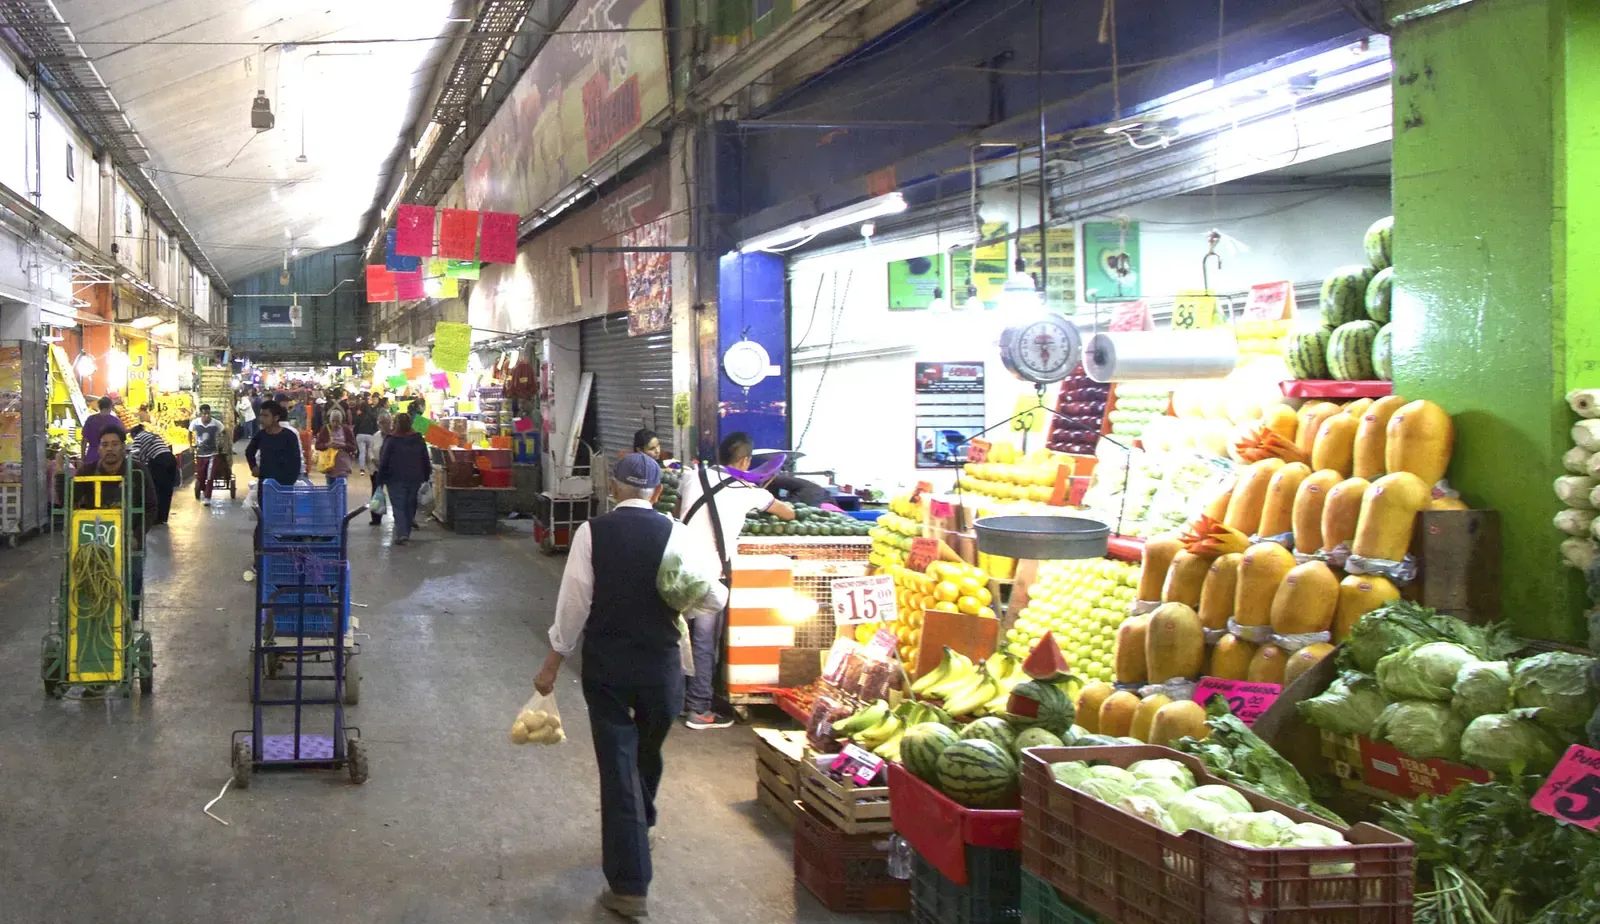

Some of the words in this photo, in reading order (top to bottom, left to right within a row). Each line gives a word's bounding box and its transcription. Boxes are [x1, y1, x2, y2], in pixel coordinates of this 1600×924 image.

[1175, 303, 1194, 328] 38
[132, 355, 143, 367] J
[1398, 757, 1441, 781] TERRA
